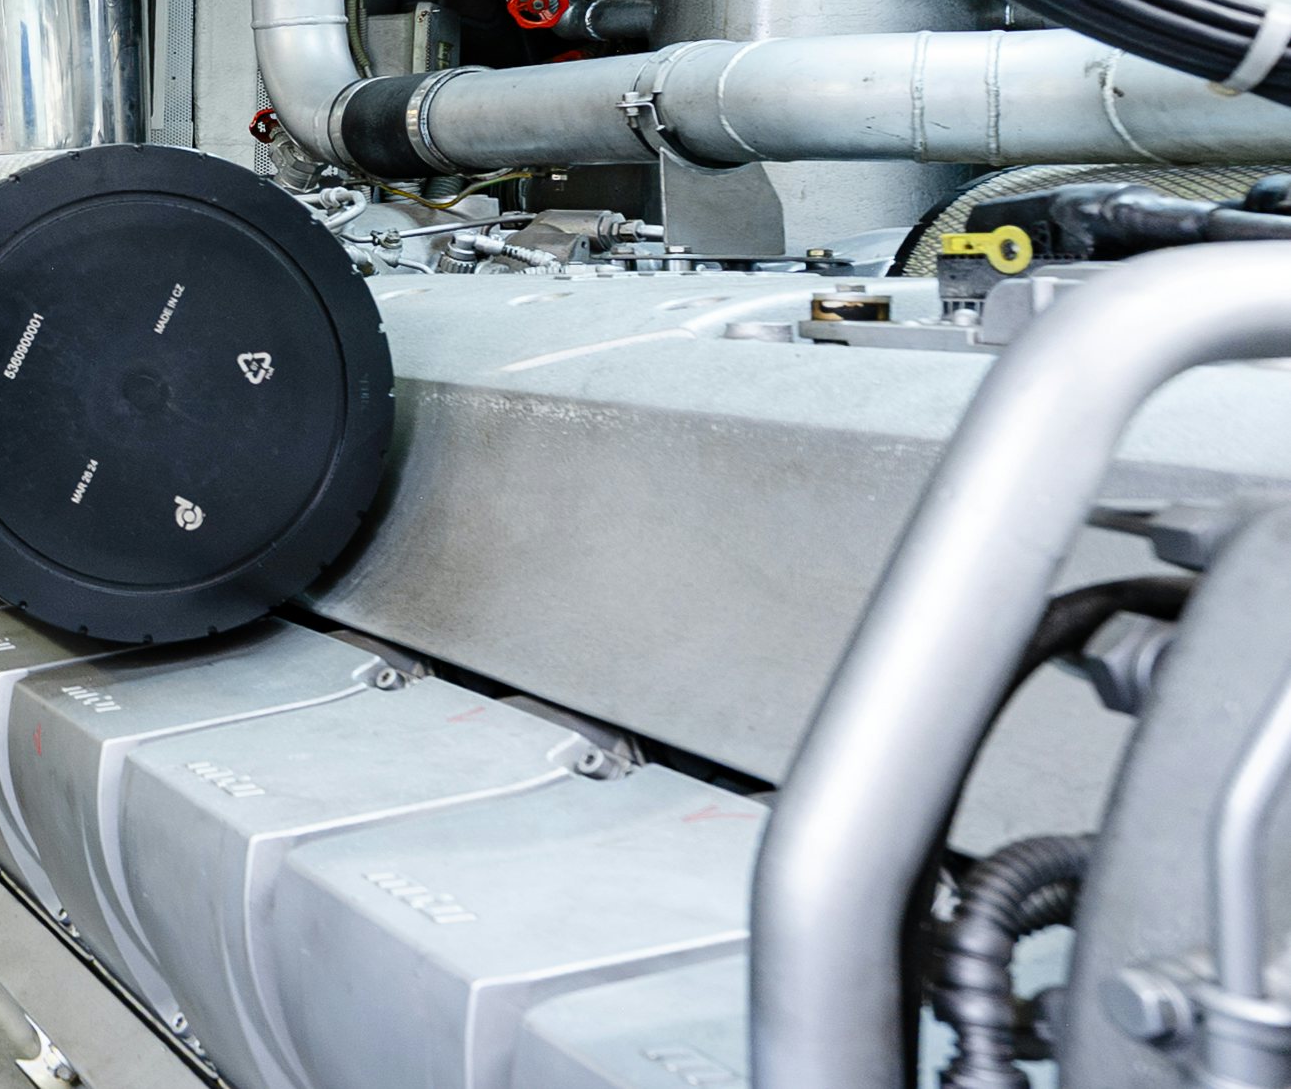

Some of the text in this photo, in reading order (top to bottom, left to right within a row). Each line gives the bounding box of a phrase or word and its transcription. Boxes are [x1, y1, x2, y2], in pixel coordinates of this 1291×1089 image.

[154, 283, 186, 334] MADE IN CZ
[71, 459, 99, 504] MAR 20 24
